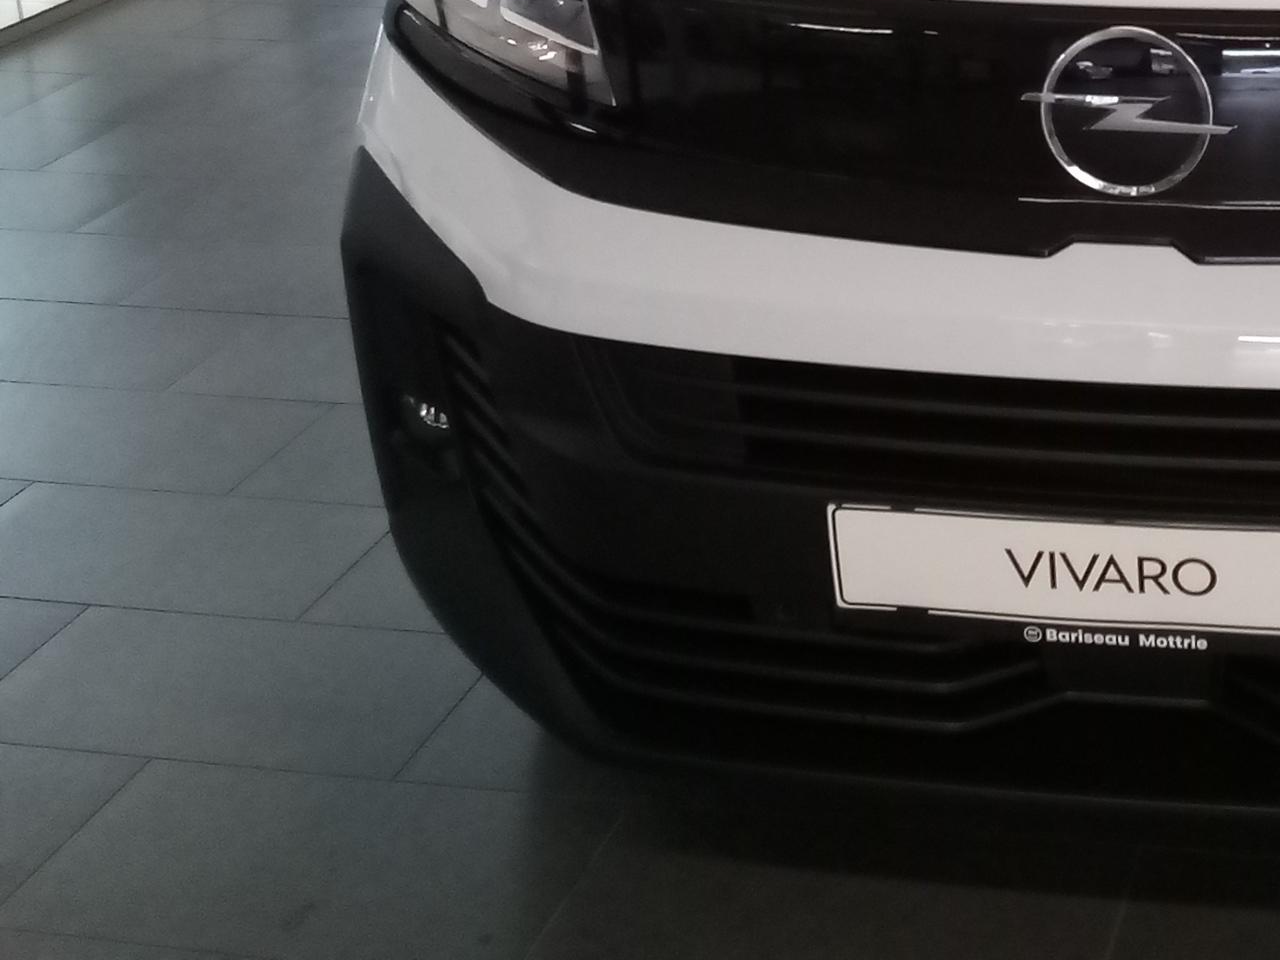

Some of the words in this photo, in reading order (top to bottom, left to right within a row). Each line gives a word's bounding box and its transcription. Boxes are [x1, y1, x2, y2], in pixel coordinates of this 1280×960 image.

[1004, 547, 1218, 597] VIVARO
[1045, 628, 1130, 647] Bariseau
[1138, 633, 1208, 651] Mottrie
